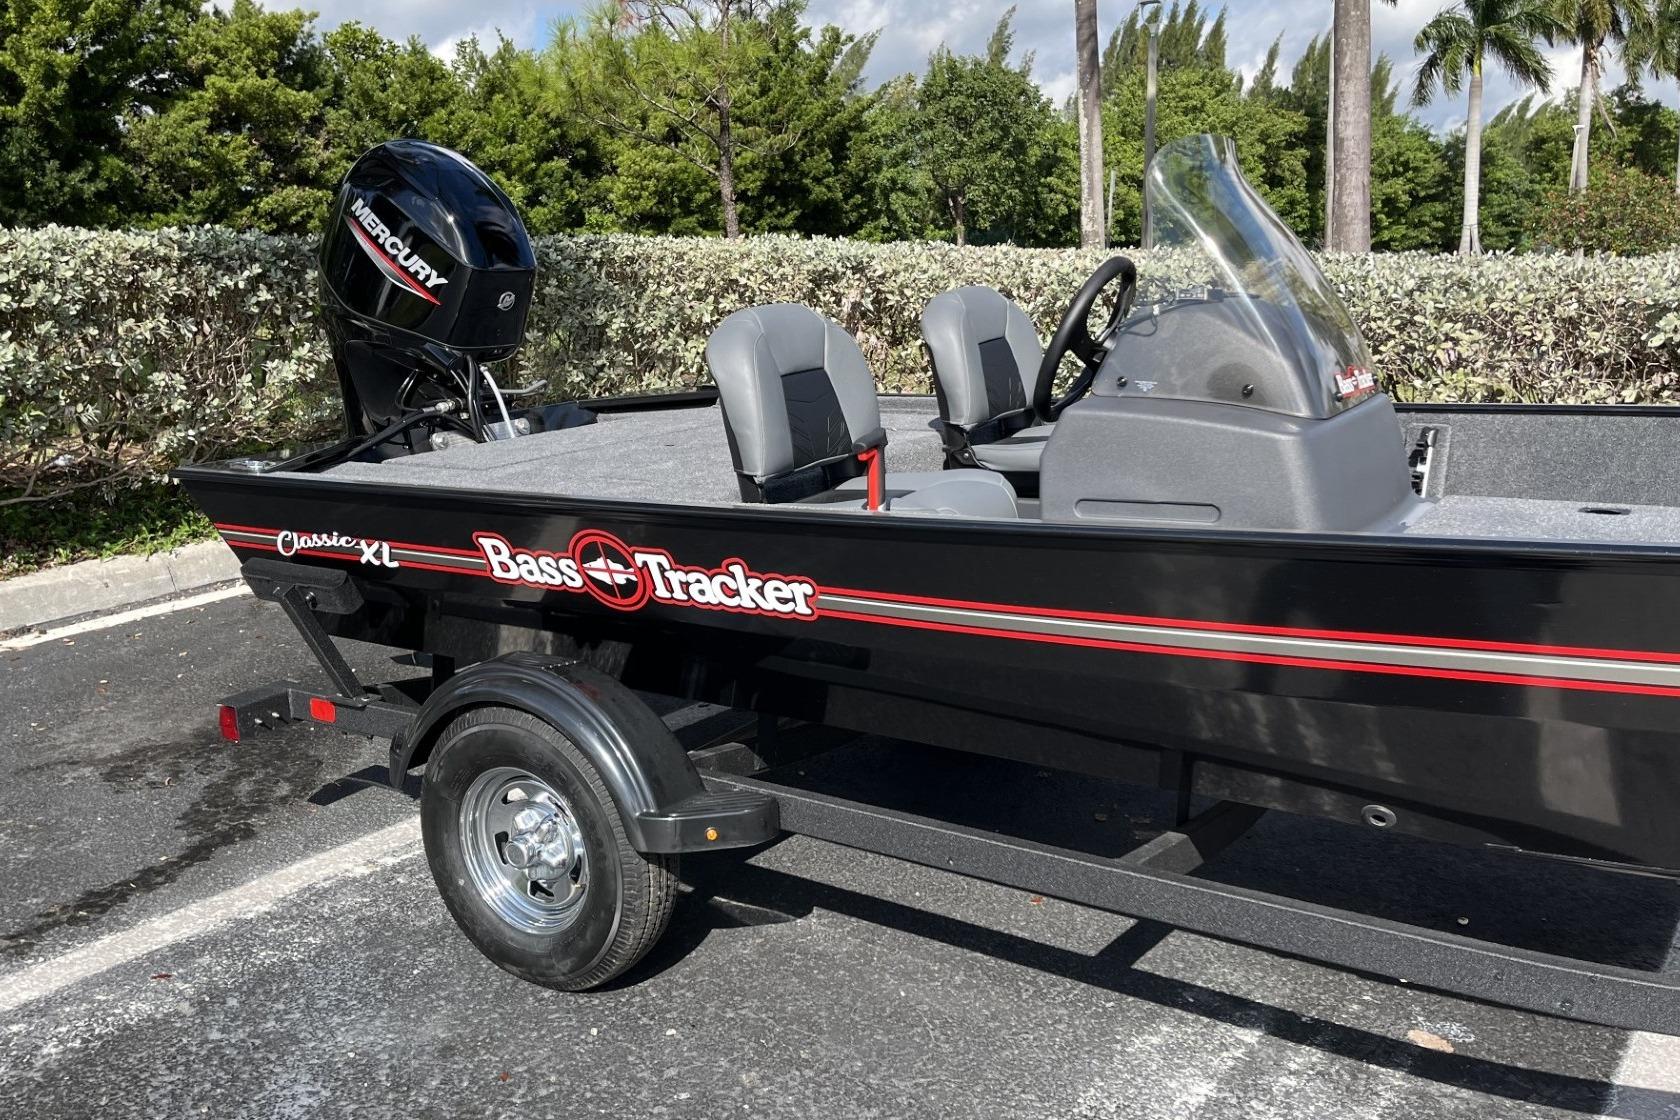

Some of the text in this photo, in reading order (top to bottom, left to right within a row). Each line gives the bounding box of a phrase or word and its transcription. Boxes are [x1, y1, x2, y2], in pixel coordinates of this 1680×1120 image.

[351, 198, 448, 288] MERCURY
[277, 530, 399, 568] Classic XL
[478, 537, 814, 615] Bass Tracker
